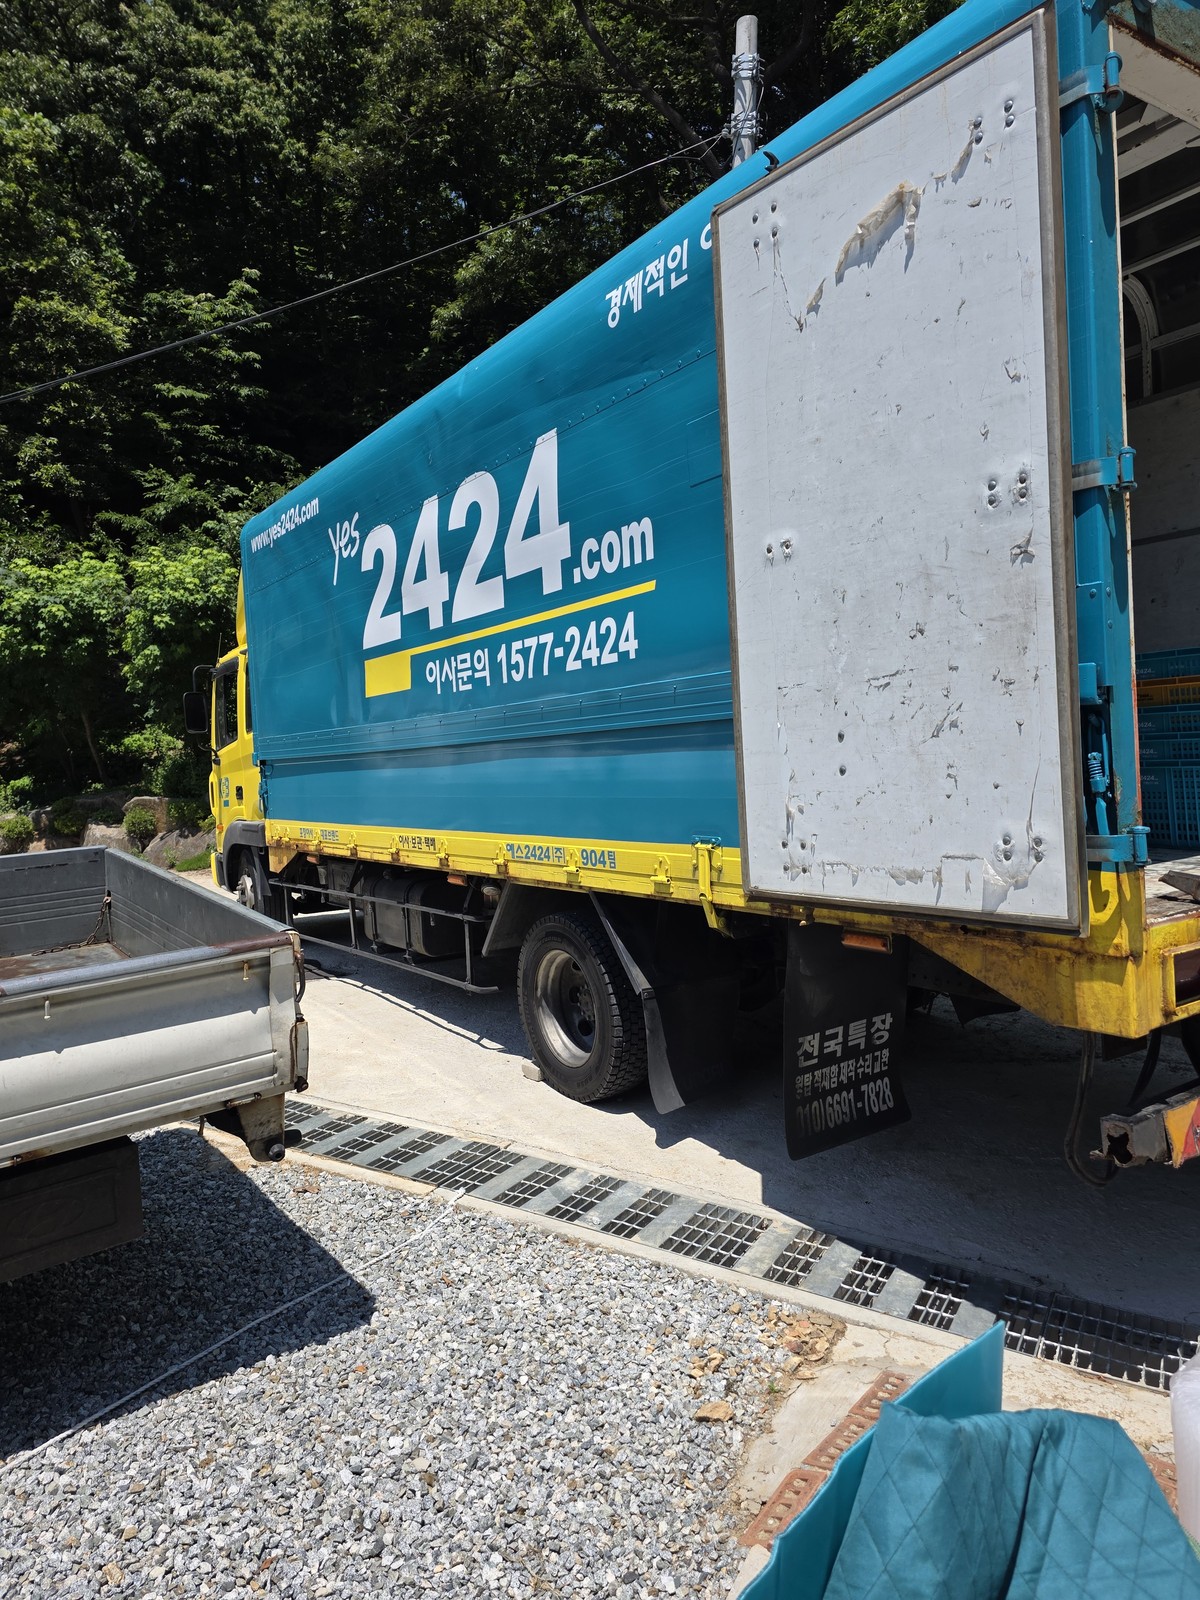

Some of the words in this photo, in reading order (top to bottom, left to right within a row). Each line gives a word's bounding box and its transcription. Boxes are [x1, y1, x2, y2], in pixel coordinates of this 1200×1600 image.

[605, 238, 688, 328] 경제적인
[251, 497, 319, 553] www.yes2424.com
[426, 648, 490, 694] 이사문의
[496, 611, 638, 684] 1577-2424
[581, 849, 616, 869] 904팀
[796, 1012, 893, 1068] 전국특장
